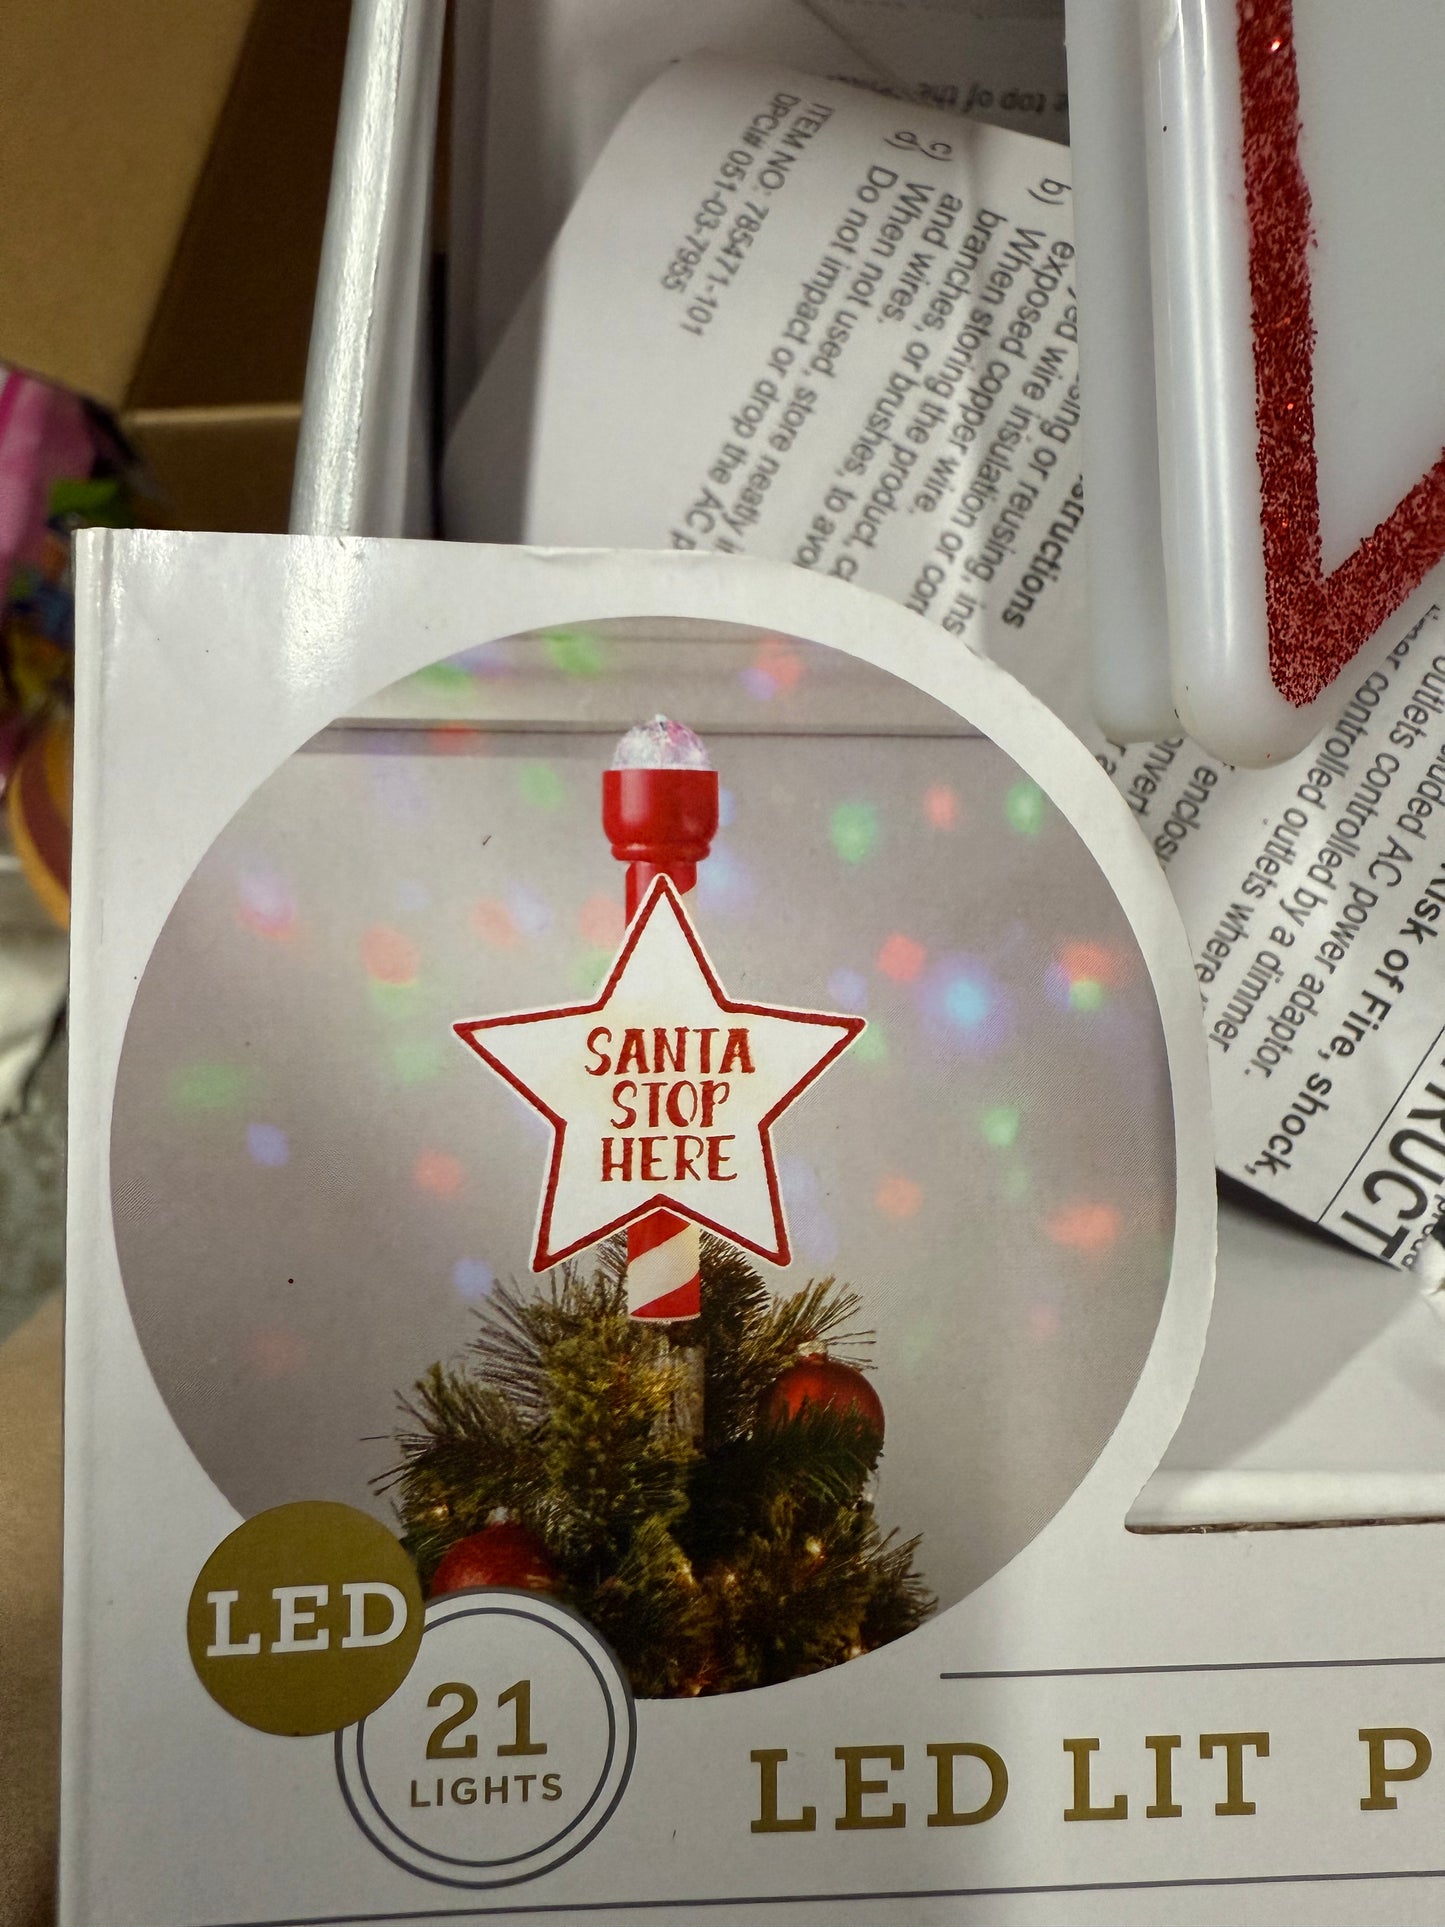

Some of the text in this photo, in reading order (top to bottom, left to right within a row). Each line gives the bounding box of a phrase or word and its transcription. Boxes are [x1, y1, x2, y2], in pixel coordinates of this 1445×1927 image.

[883, 131, 920, 151] d)
[918, 142, 952, 161] c)
[661, 93, 800, 293] DPCI# 051-03-7955
[856, 165, 899, 203] Do
[1027, 178, 1072, 205] b)
[680, 104, 834, 336] ITEM NO: 785471-101
[830, 208, 868, 255] not
[871, 183, 935, 258] When
[921, 193, 962, 250] and
[782, 255, 851, 345] impact
[845, 262, 884, 308] not
[913, 207, 1008, 331] branches,
[979, 228, 1047, 305] When
[999, 241, 1075, 360] exposed
[767, 346, 795, 378] or
[801, 310, 858, 378] used,
[902, 341, 930, 373] or
[921, 307, 994, 406] storing
[1022, 346, 1068, 400] wire
[731, 379, 780, 439] drop
[768, 386, 817, 452] store
[835, 371, 921, 477] brushes,
[905, 400, 949, 444] the
[948, 360, 1010, 454] copper
[708, 442, 749, 485] the
[713, 454, 780, 537] neatly
[842, 442, 919, 548] product,
[950, 404, 1042, 528] insulation
[1028, 446, 1057, 481] or
[684, 487, 725, 534] AC
[824, 485, 857, 513] to
[961, 480, 1039, 583] reusing,
[935, 531, 963, 564] or
[1002, 474, 1084, 628] structions
[1194, 672, 1389, 983] controlled outlets where
[1307, 753, 1400, 890] controlled
[1368, 835, 1413, 887] AC
[1269, 926, 1295, 947] a
[1279, 886, 1328, 927] by
[1314, 882, 1378, 974] power
[1209, 951, 1284, 1053] dimmer
[1374, 949, 1409, 993] of
[584, 1026, 755, 1076] SANTA
[1245, 973, 1324, 1078] adaptor.
[1318, 990, 1392, 1060] Fire,
[610, 1080, 730, 1129] STOP
[1245, 1073, 1332, 1175] shock,
[600, 1134, 738, 1182] HERE
[206, 1582, 408, 1657] LED
[425, 1679, 548, 1759] 21
[410, 1774, 563, 1807] LIGHTS
[750, 1727, 1432, 1833] LED LIT P
